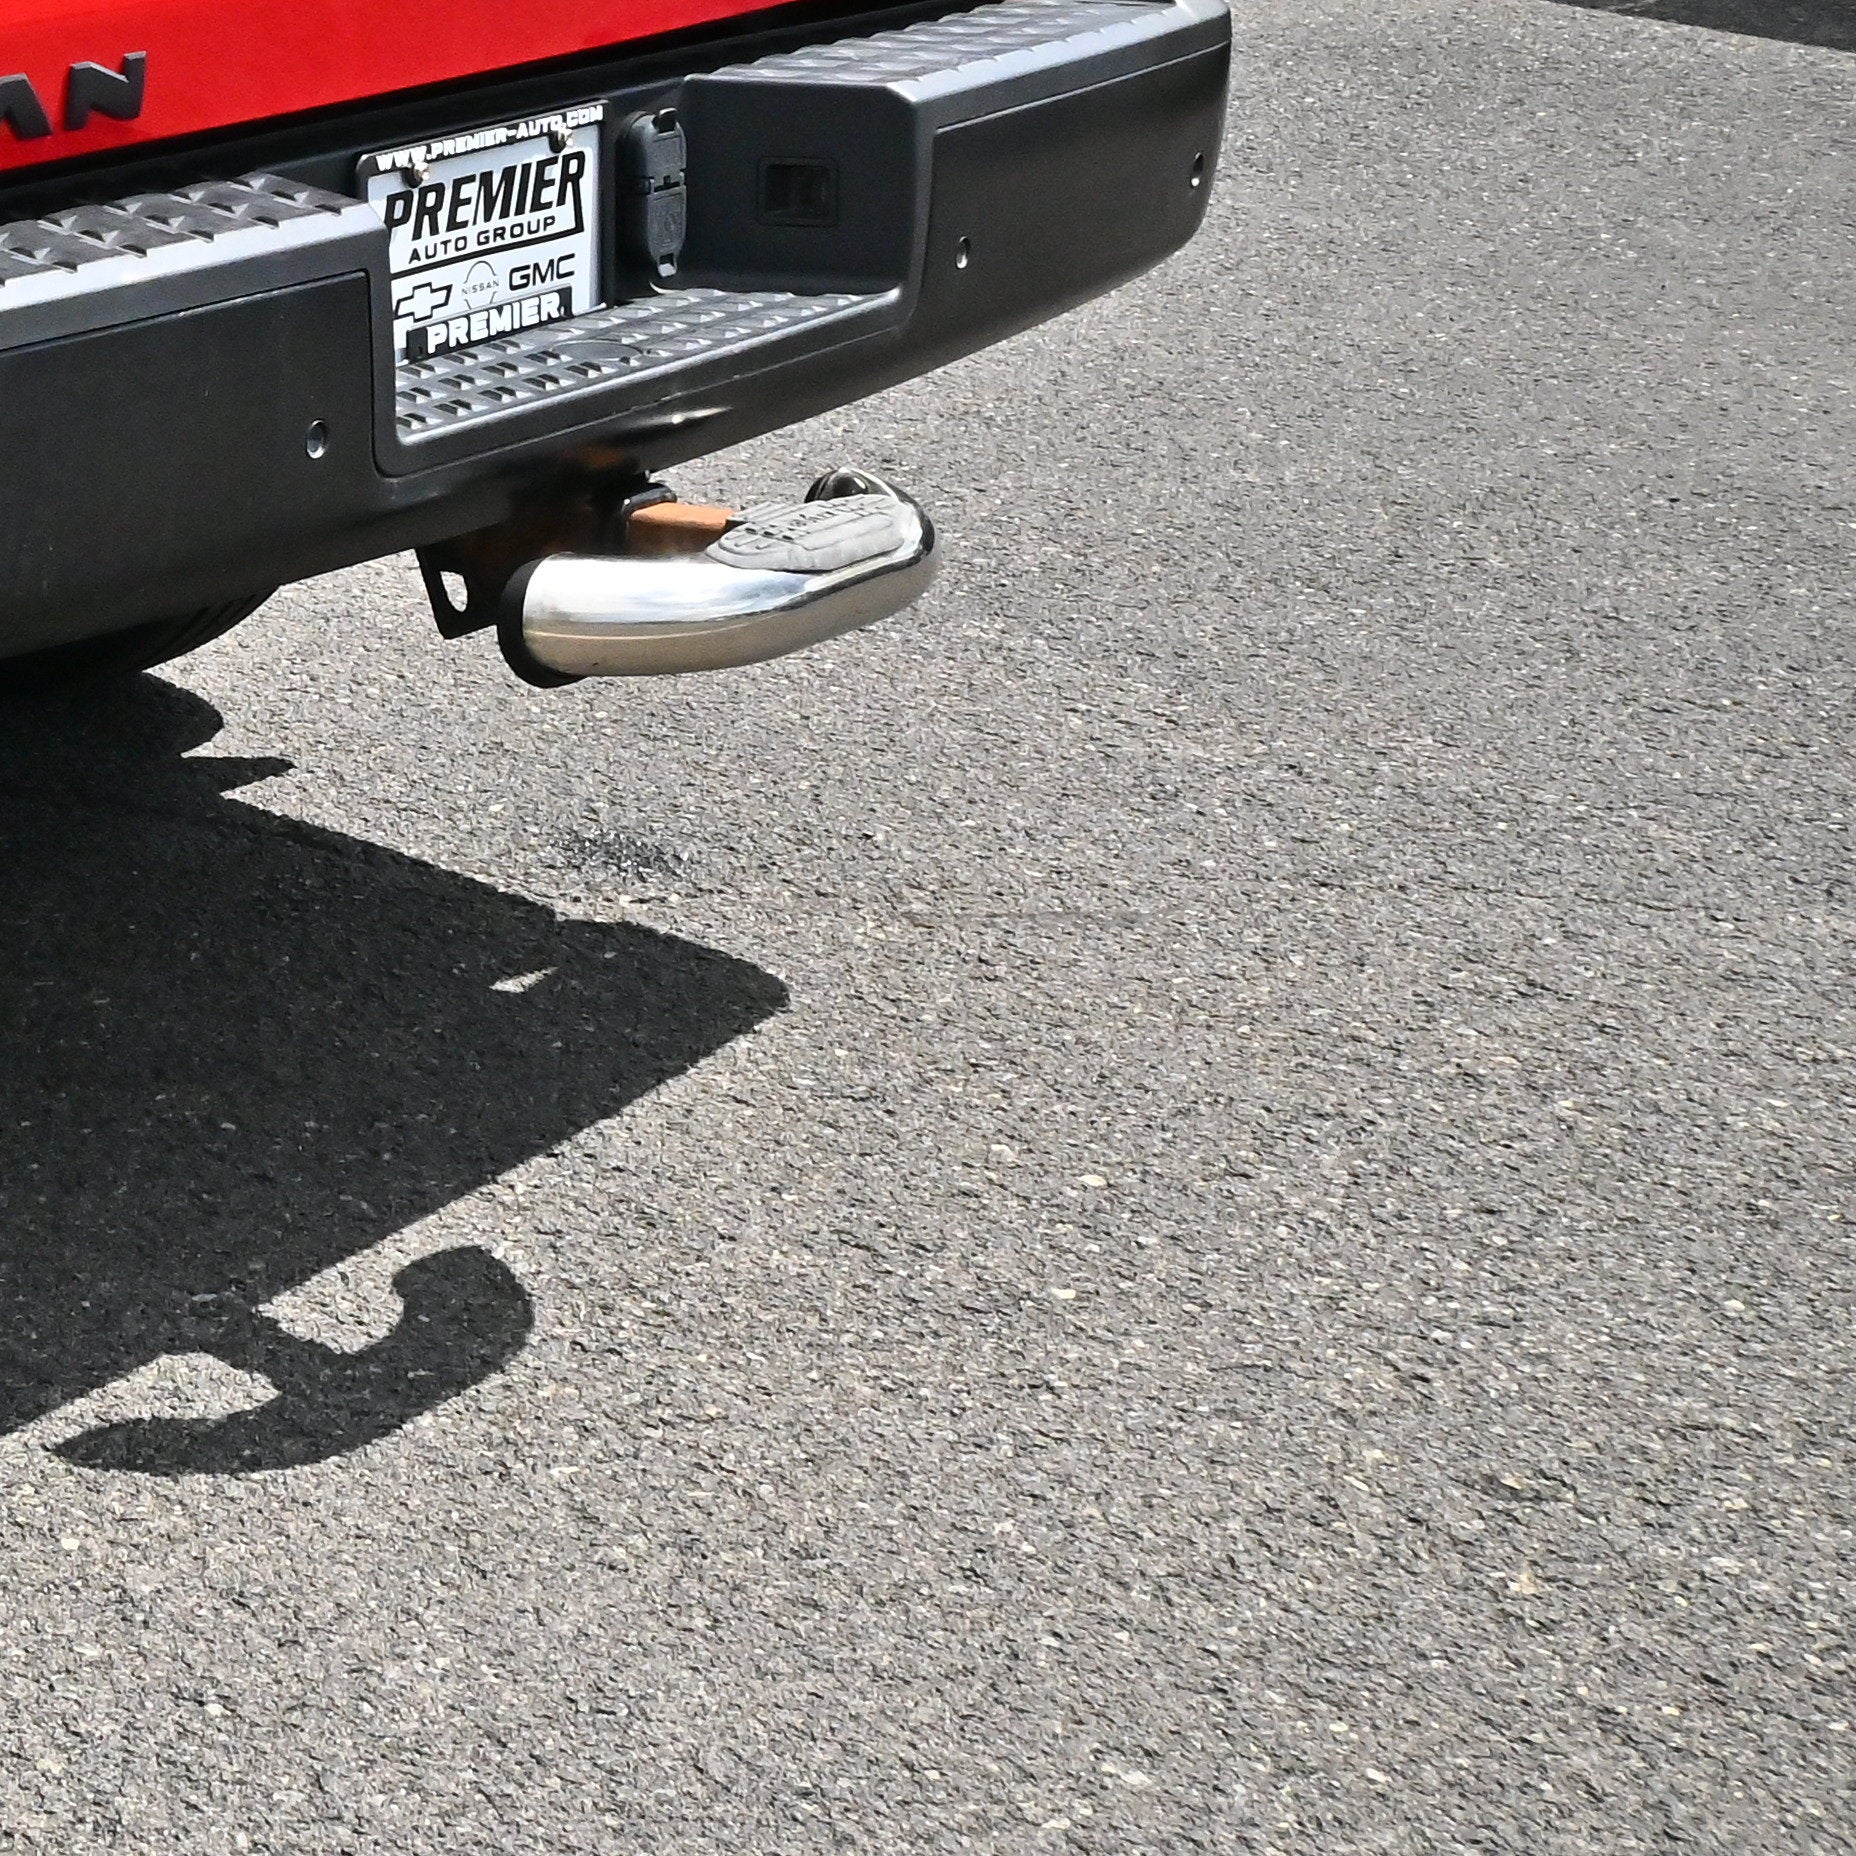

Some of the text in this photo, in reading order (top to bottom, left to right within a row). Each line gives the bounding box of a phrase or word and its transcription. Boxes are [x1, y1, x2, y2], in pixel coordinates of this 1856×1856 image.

[384, 150, 586, 242] PREMIER
[408, 215, 557, 265] AUTO GROUP
[460, 279, 500, 296] NISSAN
[508, 252, 576, 292] GMC
[426, 291, 561, 355] PREMIER
